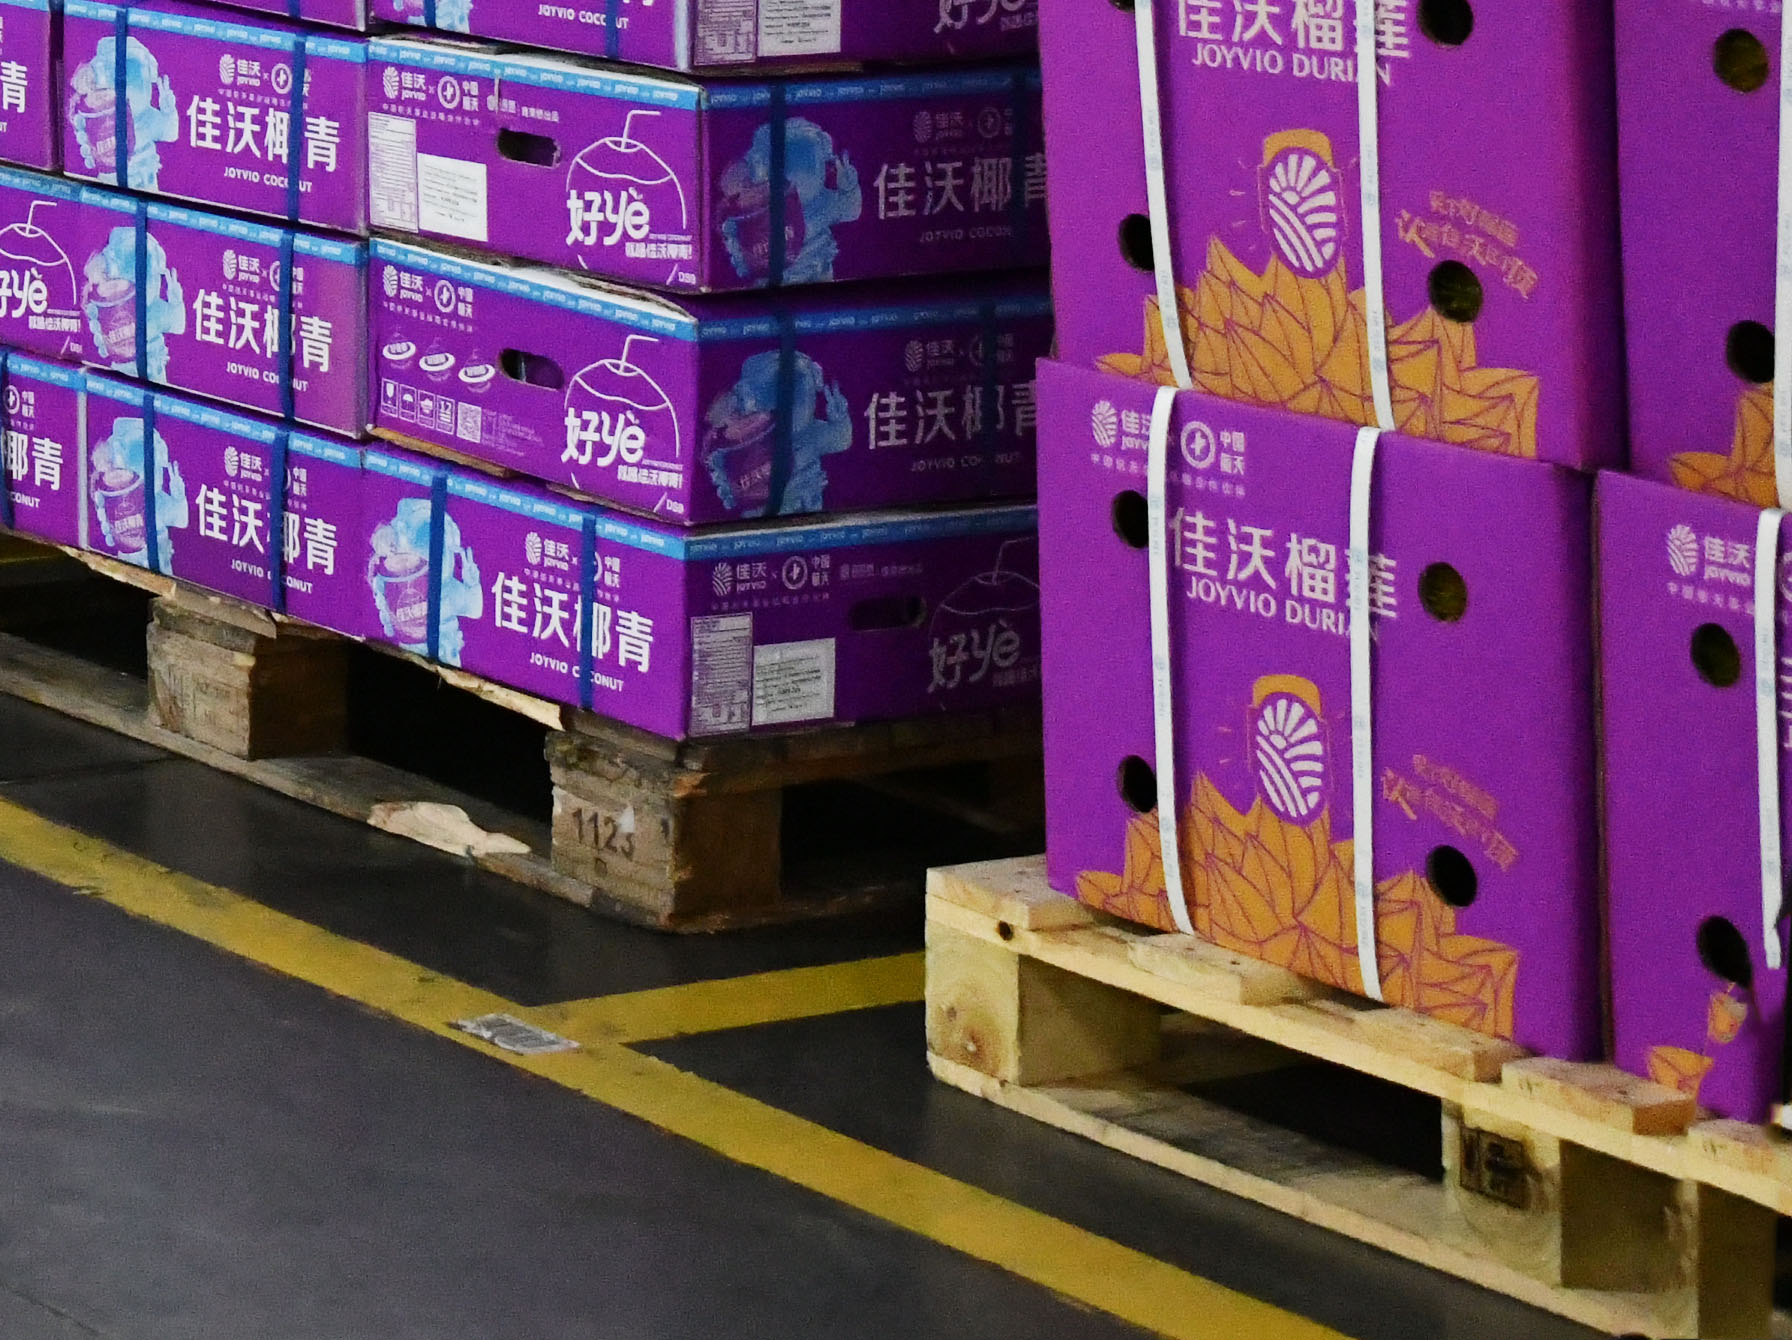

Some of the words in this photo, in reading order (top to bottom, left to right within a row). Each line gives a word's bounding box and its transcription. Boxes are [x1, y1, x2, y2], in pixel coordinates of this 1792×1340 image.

[537, 5, 575, 20] JOYVIO
[1191, 42, 1283, 73] JOYVIO
[398, 72, 429, 91] 佳沃
[187, 91, 340, 176] 佳沃椰青
[223, 168, 260, 182] JOYVIO
[397, 263, 426, 290] 佳沃
[193, 286, 332, 375] 佳沃椰青
[226, 362, 259, 379] JOYVIO
[196, 480, 337, 578] 佳沃椰青
[541, 539, 569, 561] 佳沃
[1171, 507, 1397, 618] 佳沃榴莲
[1704, 536, 1750, 571] 佳沃
[231, 560, 269, 577] JOYVIO
[732, 563, 766, 579] 佳沃
[1186, 574, 1276, 617] JOYVIO
[492, 568, 653, 677] 佳沃椰青
[529, 653, 568, 673] JOYVIO
